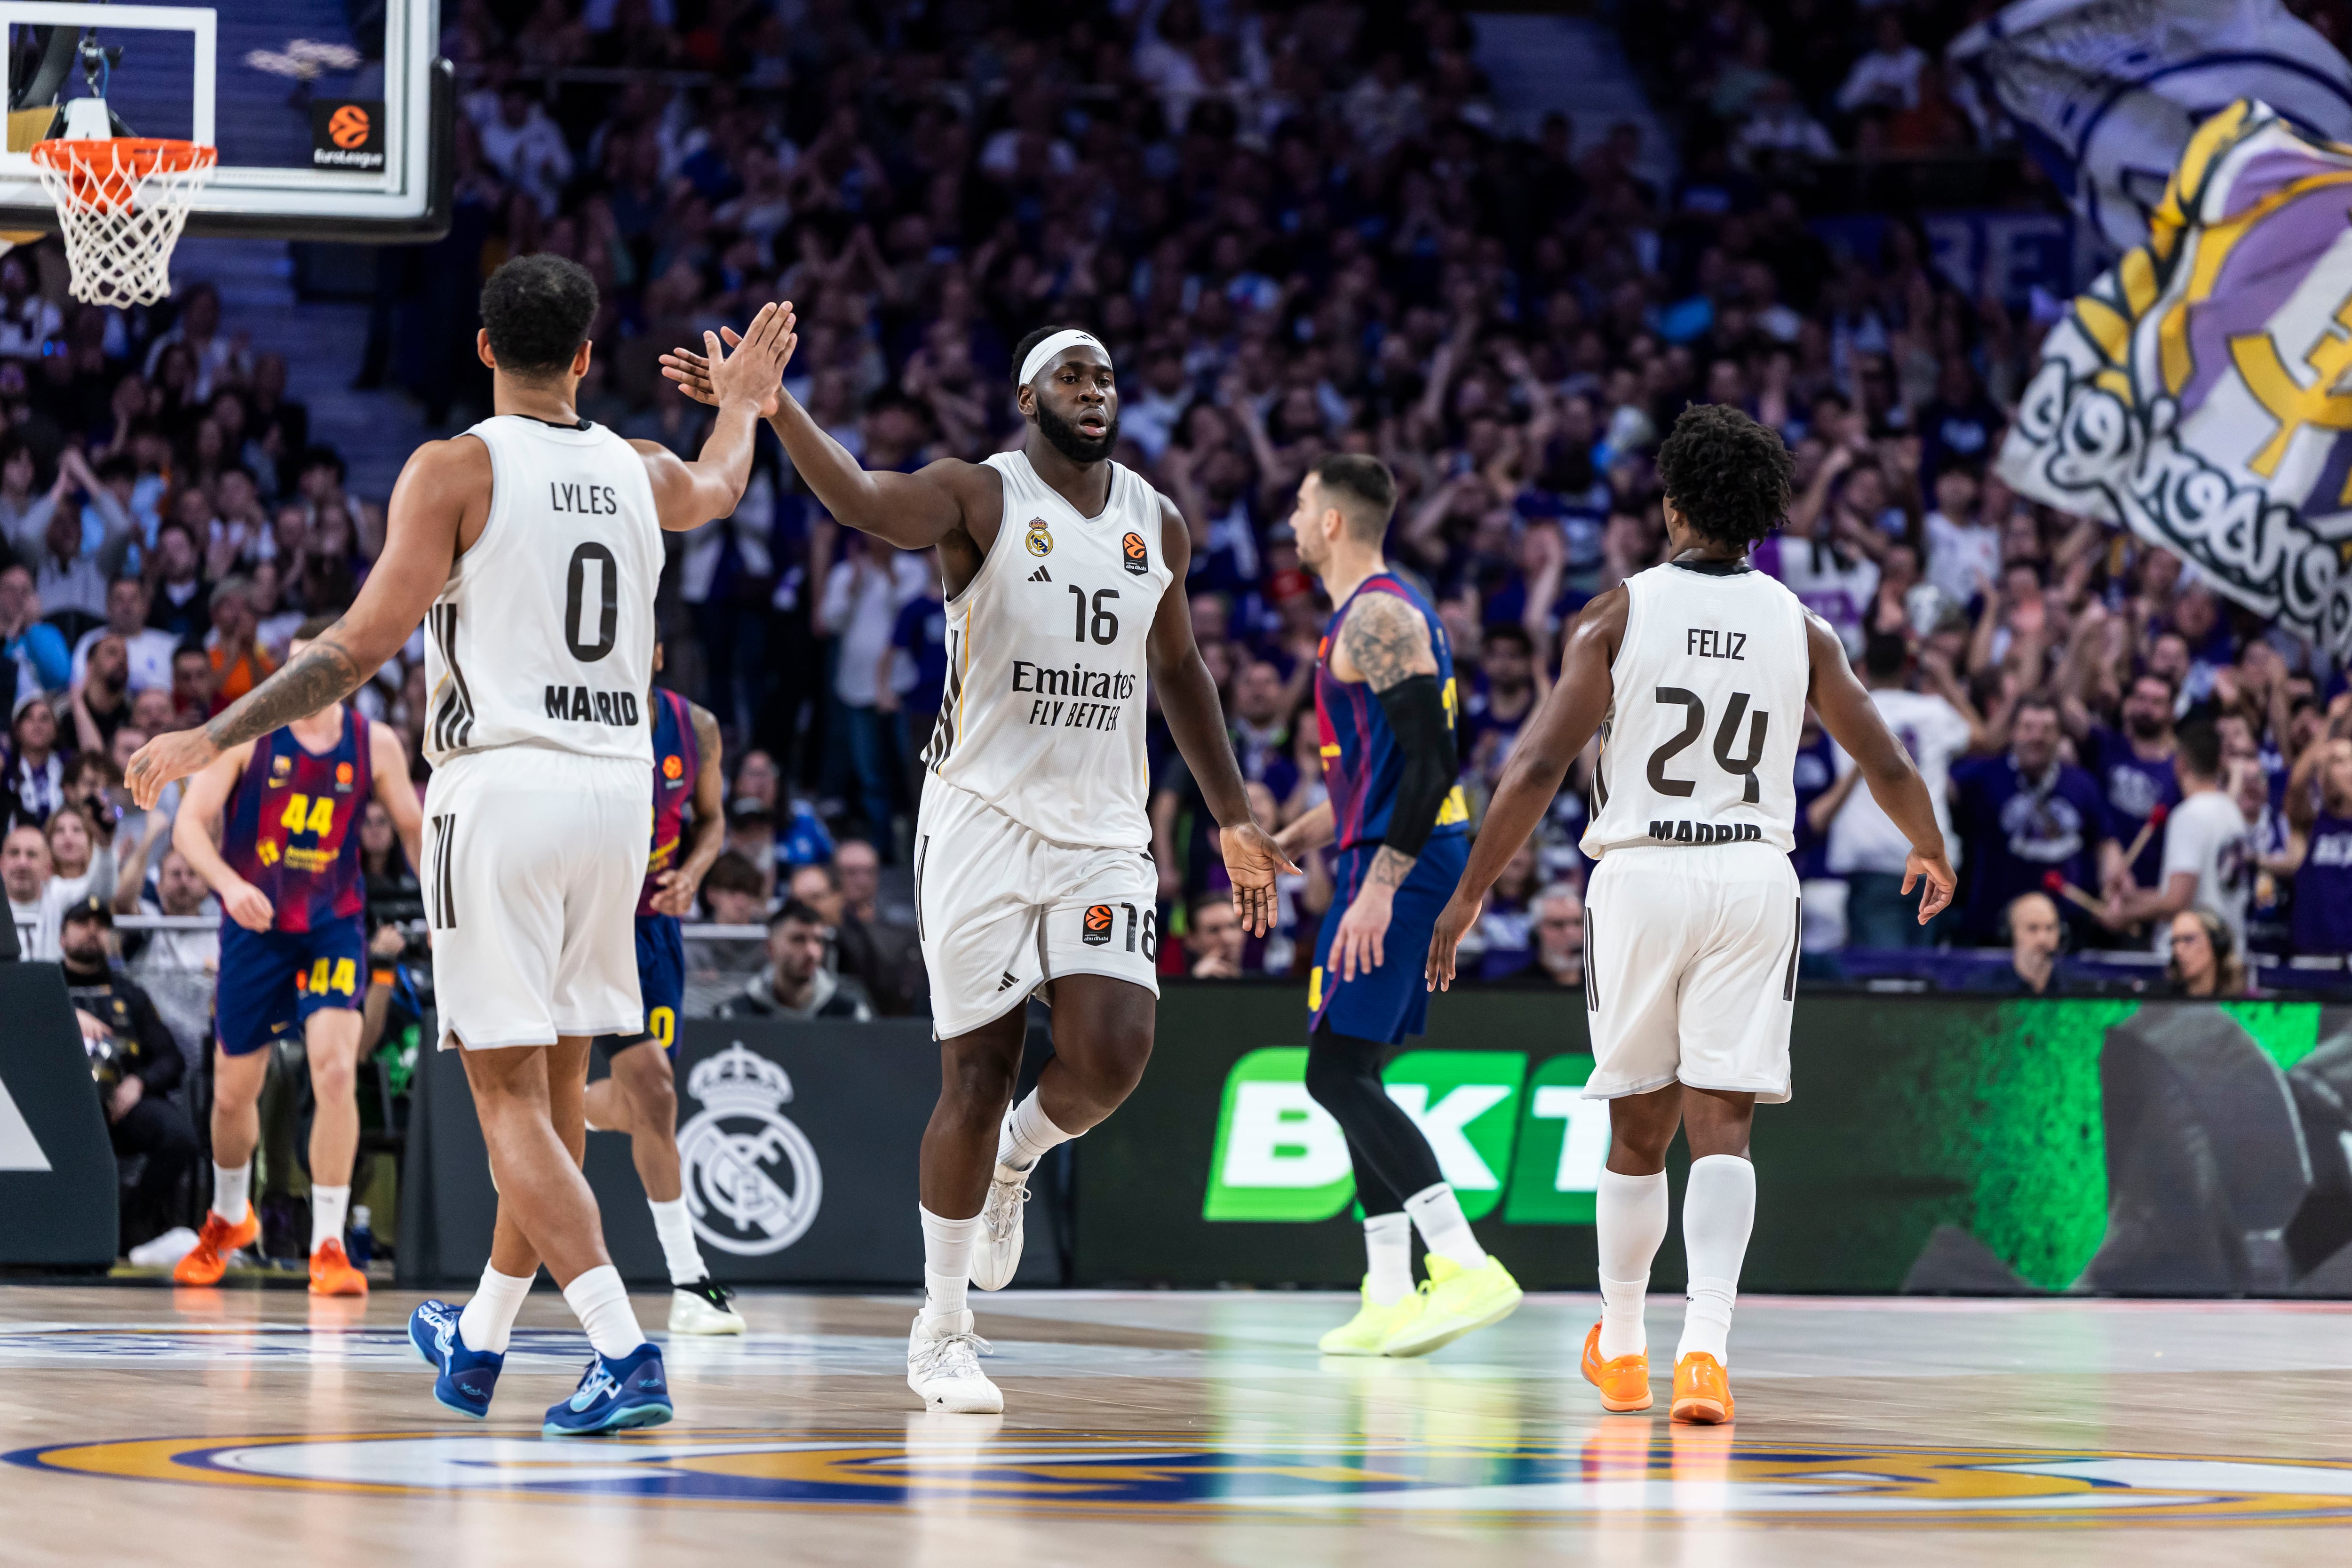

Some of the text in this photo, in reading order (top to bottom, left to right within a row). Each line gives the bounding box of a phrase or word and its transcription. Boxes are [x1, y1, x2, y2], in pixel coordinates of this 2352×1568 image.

[551, 482, 617, 515] LYLES
[565, 541, 618, 662] 0
[1068, 584, 1120, 646] 16
[1687, 628, 1747, 661] FELIZ
[1012, 660, 1136, 700] Emirates
[1029, 699, 1121, 732] FLY BETTER
[1646, 686, 1769, 804] 24
[280, 793, 335, 838] 44
[308, 957, 357, 996] 44
